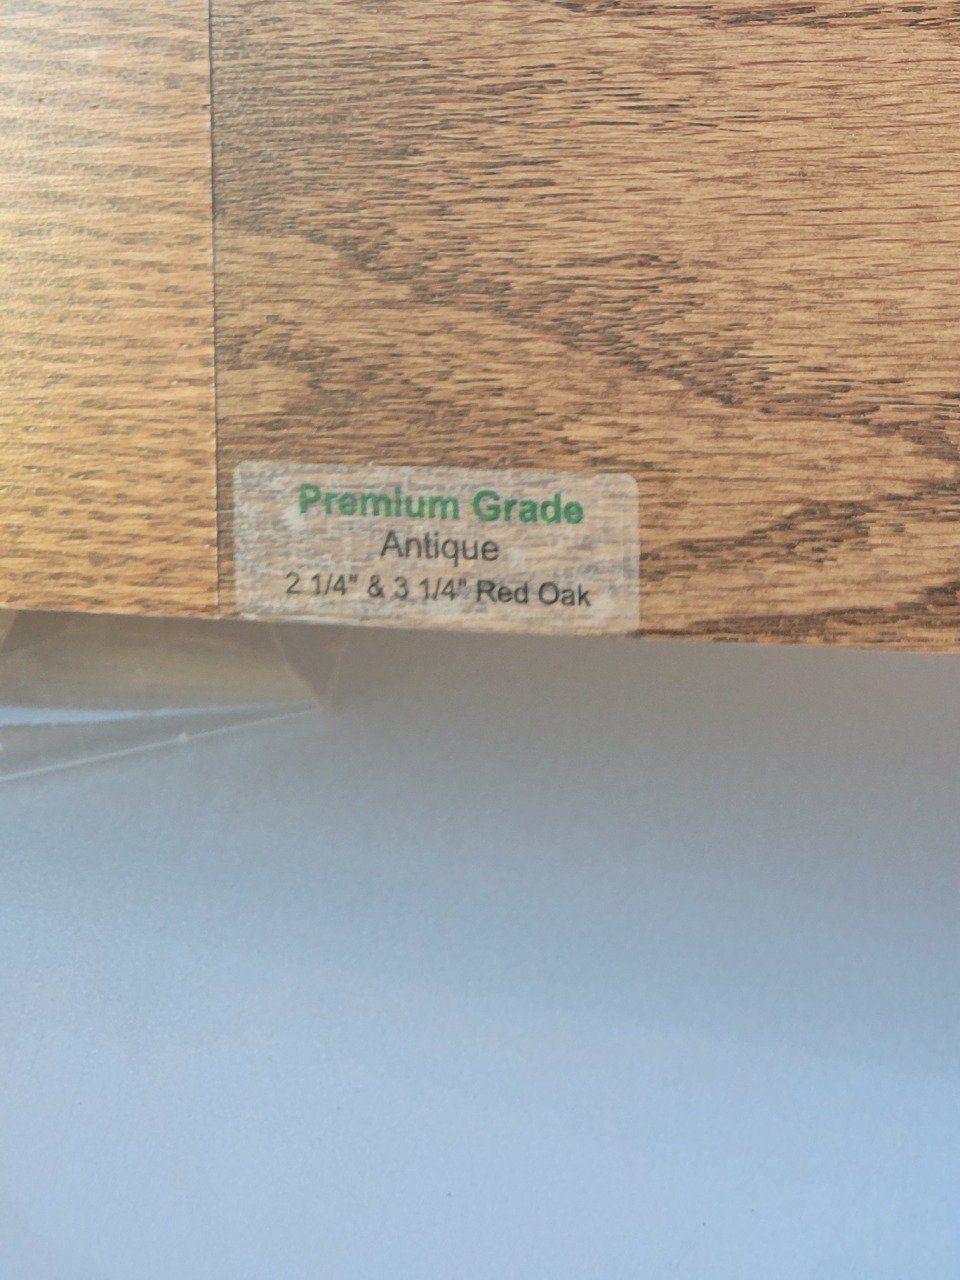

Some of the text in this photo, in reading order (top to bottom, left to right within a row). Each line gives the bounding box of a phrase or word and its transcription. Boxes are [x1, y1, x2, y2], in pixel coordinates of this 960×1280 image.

[300, 483, 585, 525] Premium Grade
[380, 530, 499, 567] Antique
[286, 572, 591, 607] 2 1/4" & 3 1/4" Red Oak
